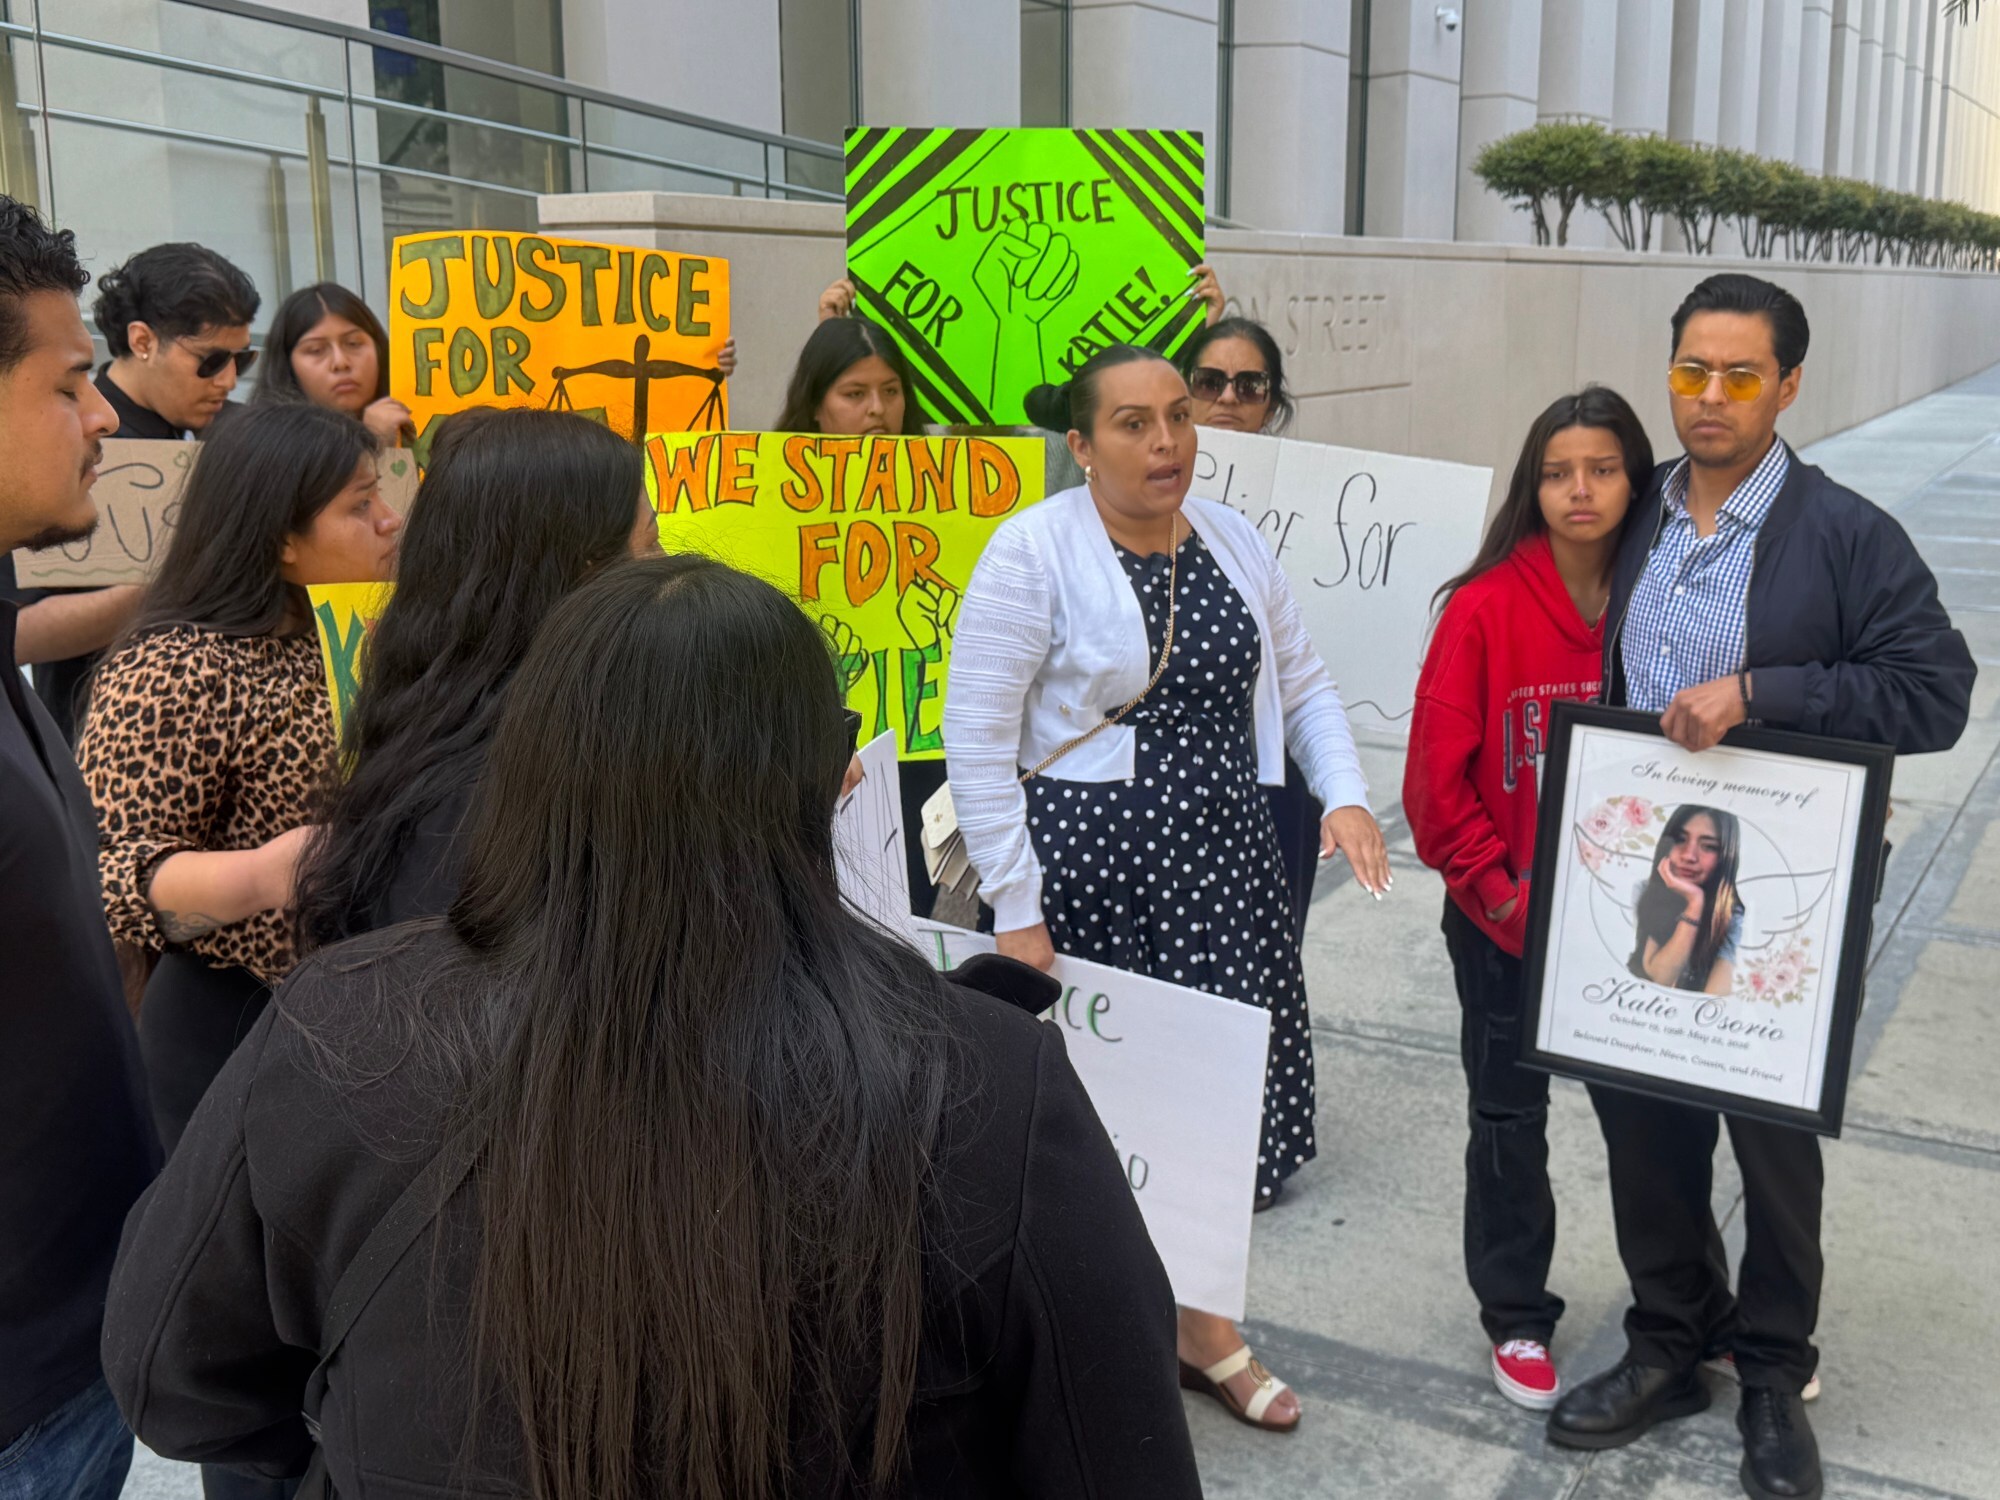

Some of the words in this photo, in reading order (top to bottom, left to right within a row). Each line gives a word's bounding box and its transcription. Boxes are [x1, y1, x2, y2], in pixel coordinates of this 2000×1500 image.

[936, 178, 1115, 240] JUSTICE
[400, 235, 711, 337] JUSTICE
[881, 260, 963, 348] FOR
[1057, 265, 1171, 378] KATIE!
[1286, 295, 1386, 356] STREET
[413, 326, 536, 398] FOR
[646, 432, 760, 514] WE
[780, 435, 1021, 518] STAND
[798, 520, 961, 608] FOR
[1631, 760, 1662, 780] In
[1666, 766, 1719, 796] loving
[1723, 780, 1790, 807] memory
[1794, 787, 1819, 809] of
[1582, 977, 1678, 1019] Katie
[1691, 996, 1785, 1042] Osorio
